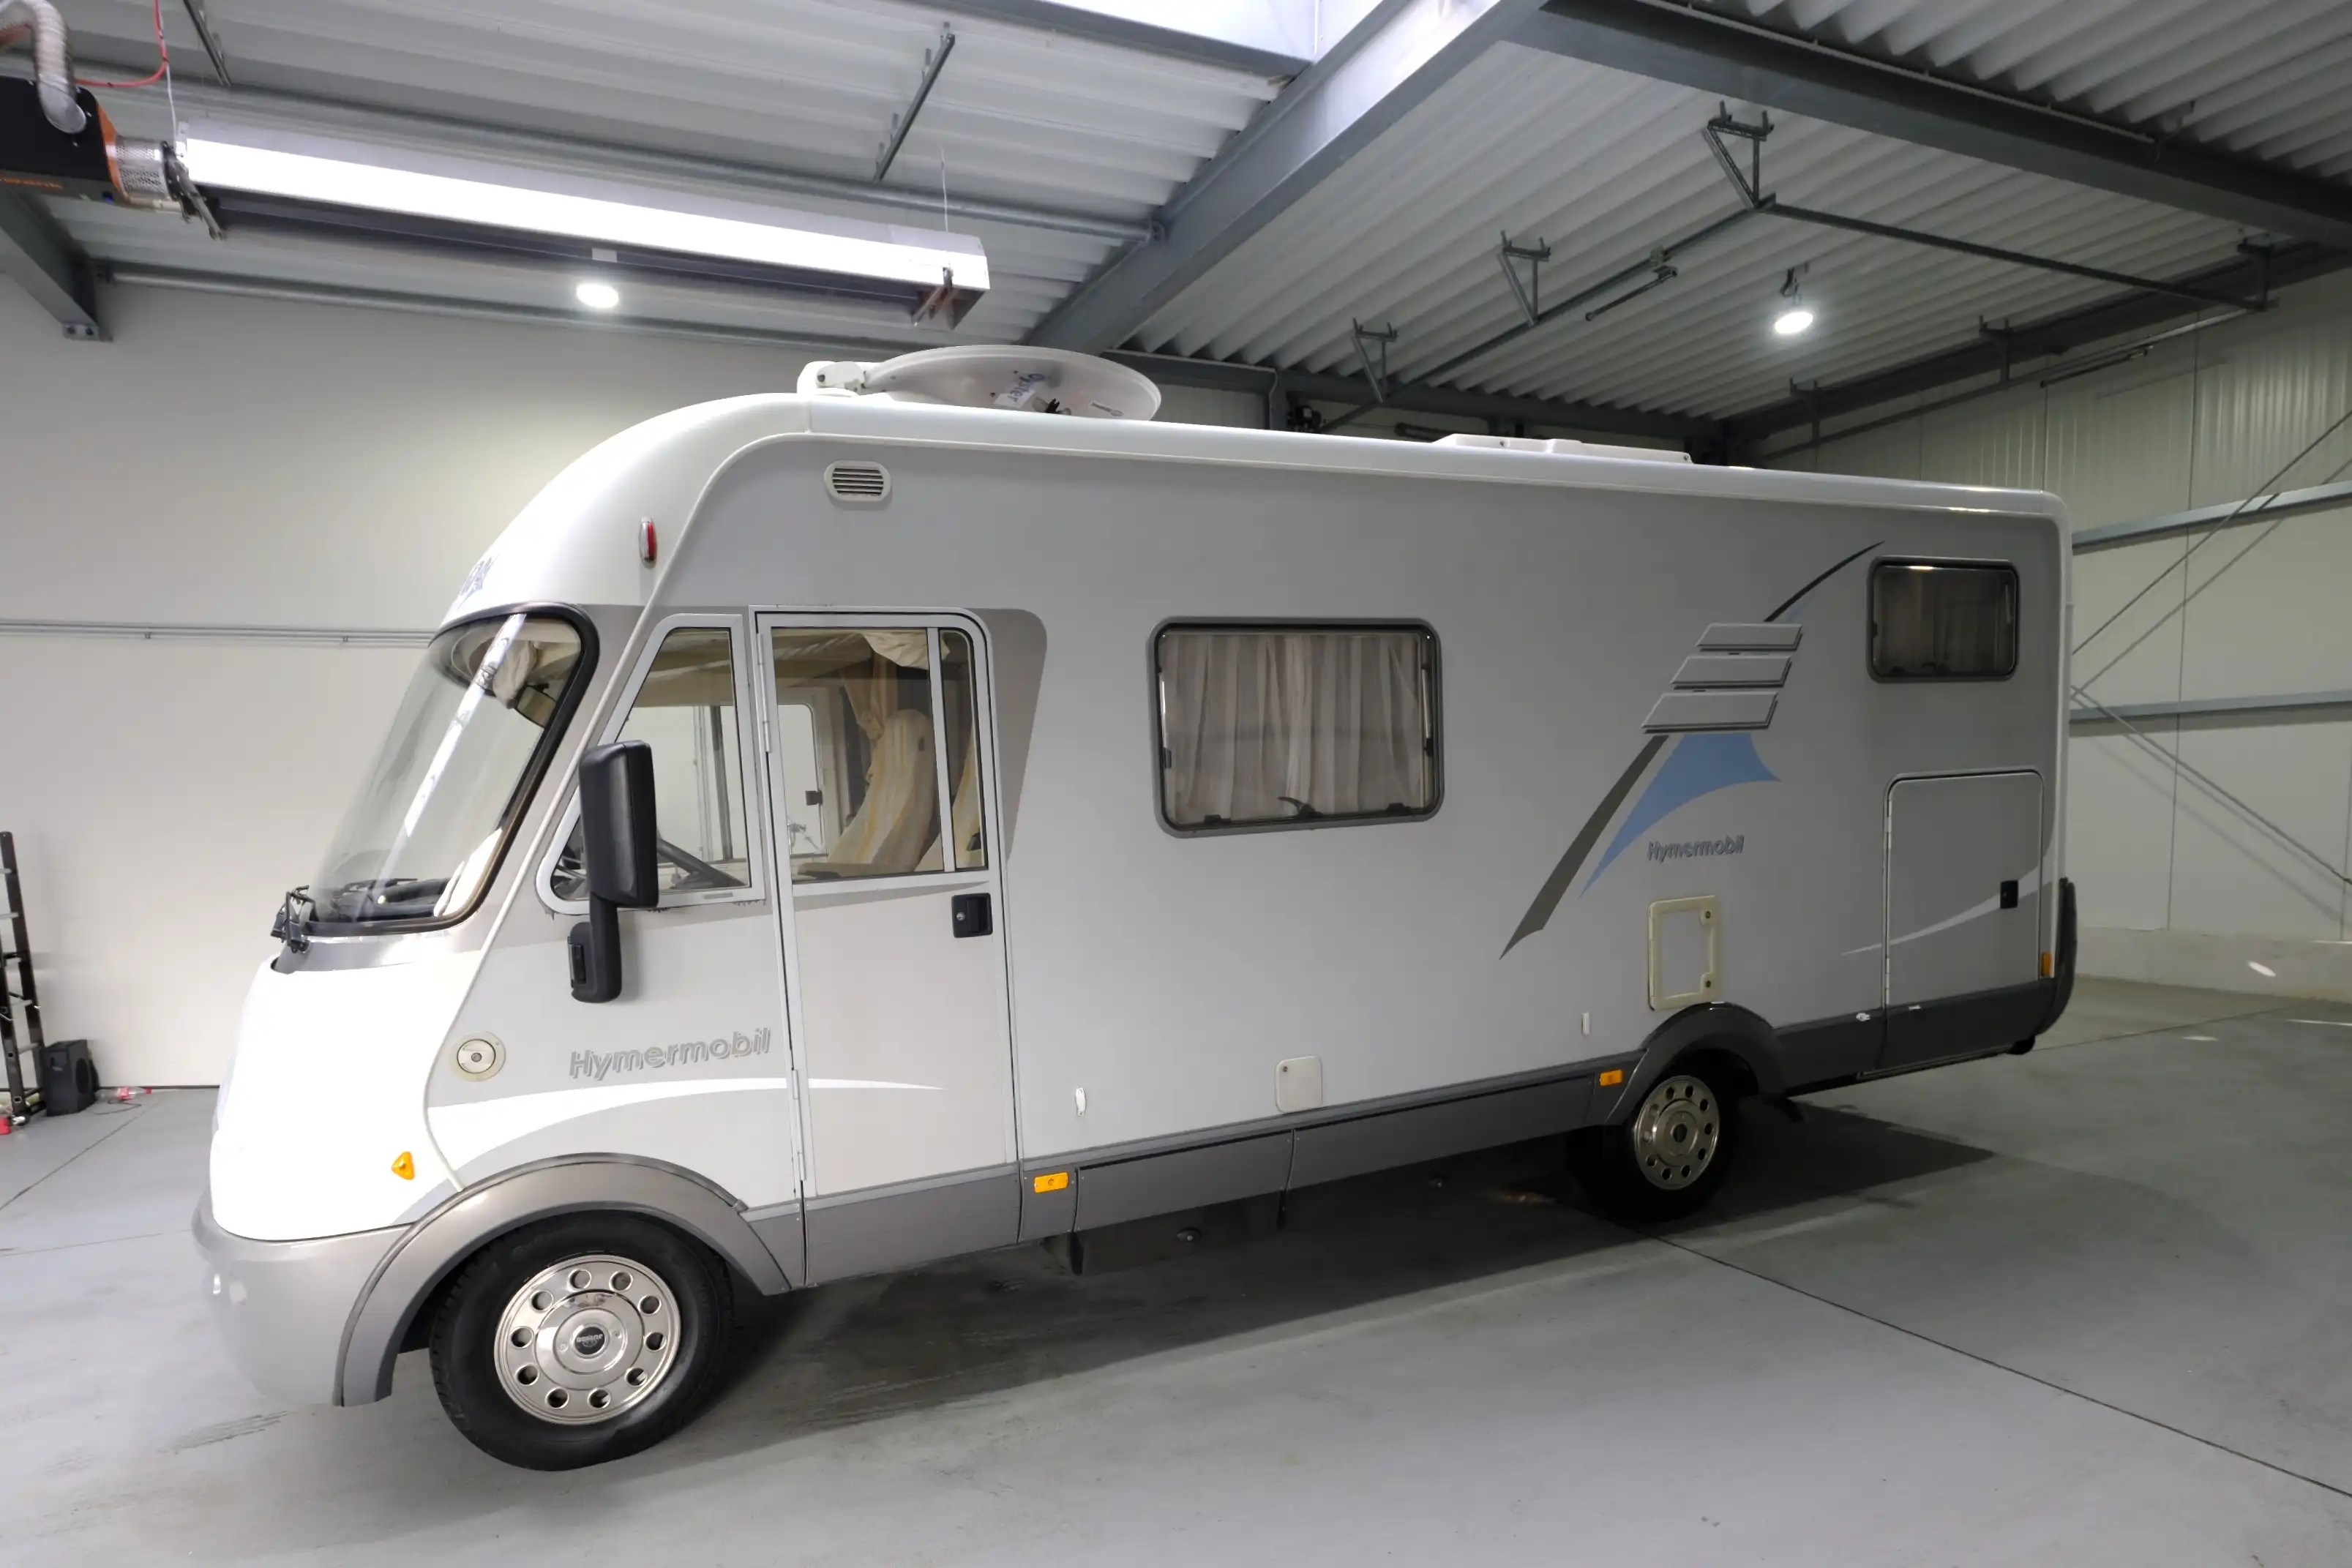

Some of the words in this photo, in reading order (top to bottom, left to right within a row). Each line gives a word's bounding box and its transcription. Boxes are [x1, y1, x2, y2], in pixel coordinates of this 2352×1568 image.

[1008, 373, 1046, 402] Oyster
[1648, 835, 1745, 863] Hymermobil
[569, 1027, 771, 1081] Hymermobil
